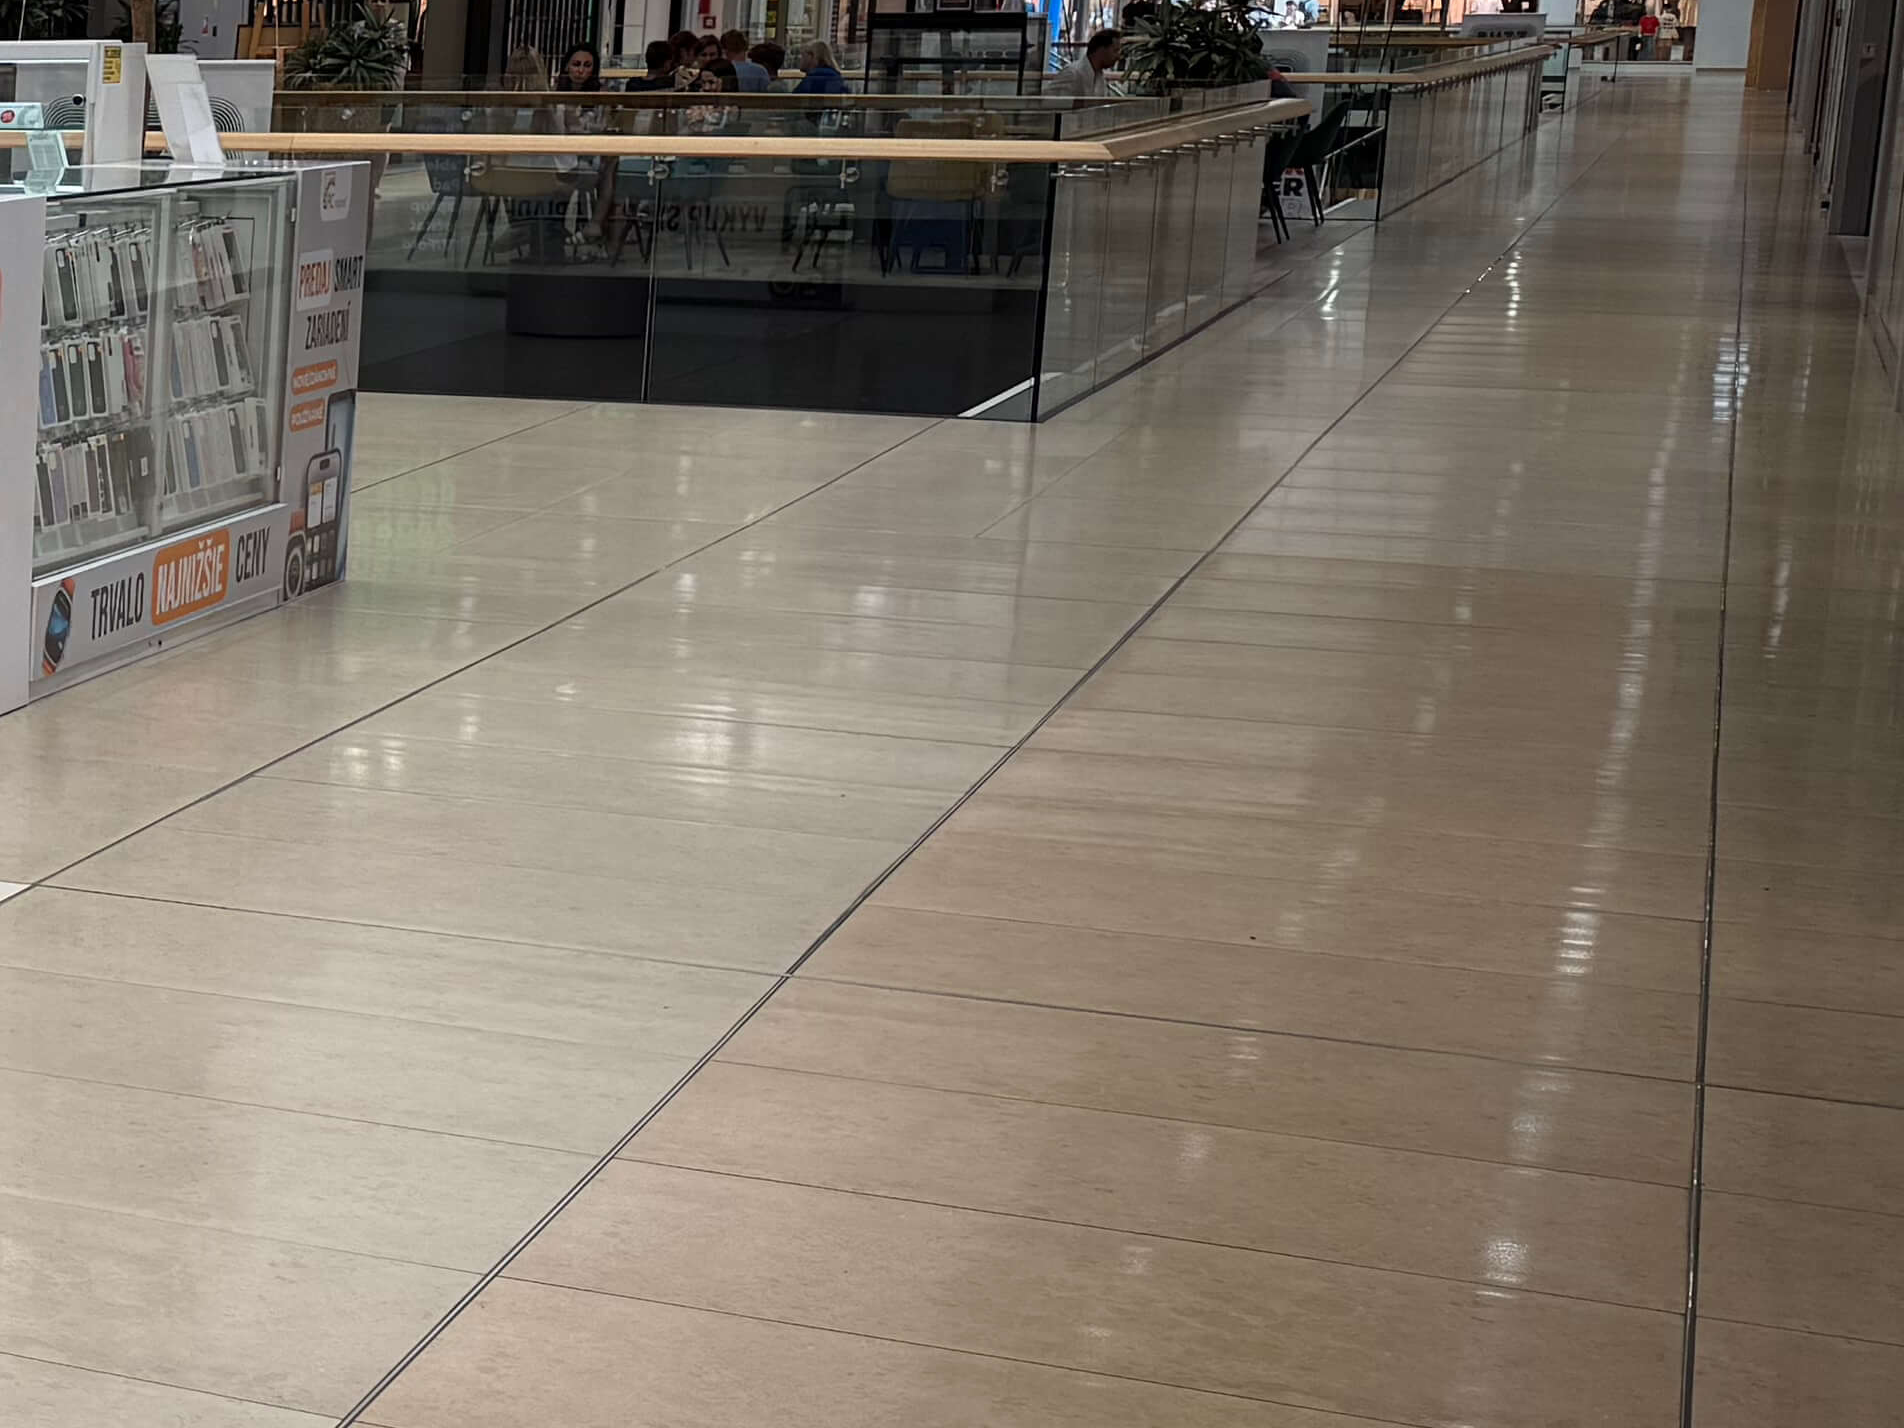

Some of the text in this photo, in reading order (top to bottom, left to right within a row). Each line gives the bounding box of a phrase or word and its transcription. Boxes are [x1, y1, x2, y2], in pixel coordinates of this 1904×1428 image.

[90, 525, 271, 641] TRVALO NAJNIŽŠIE CENY
